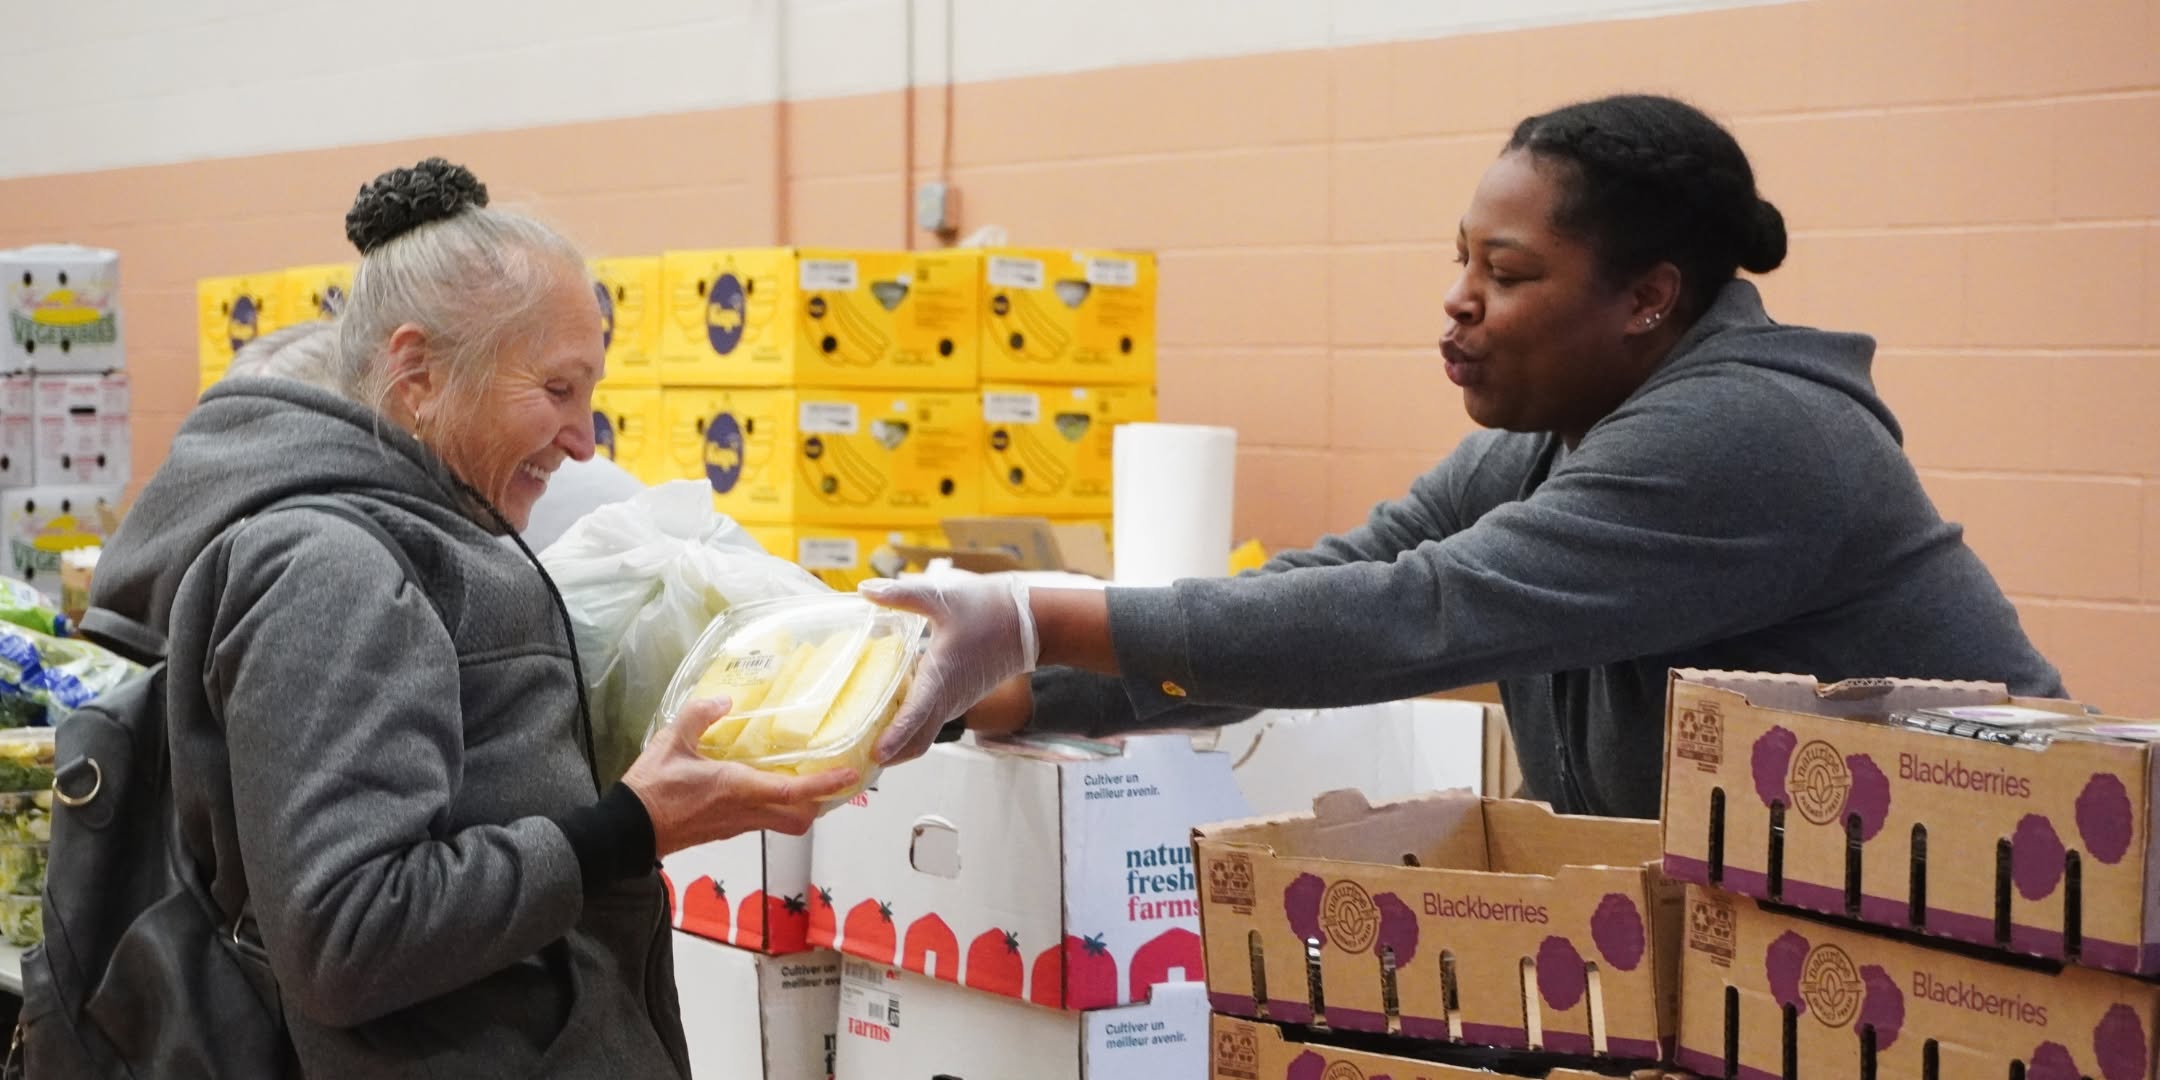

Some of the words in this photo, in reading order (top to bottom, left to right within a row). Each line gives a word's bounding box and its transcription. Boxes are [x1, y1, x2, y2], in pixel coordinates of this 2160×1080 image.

[1084, 774, 1123, 786] Cultiver
[1126, 774, 1139, 783] un
[1899, 752, 2031, 798] Blackberries
[1085, 787, 1124, 800] meilleur
[1127, 785, 1160, 797] avenir.
[1127, 866, 1195, 894] fresh
[1128, 896, 1199, 921] farms
[1423, 892, 1549, 924] Blackberries
[781, 964, 820, 976] Cultiver
[824, 964, 837, 973] un
[782, 977, 821, 988] meilleur
[1912, 970, 2048, 1026] Blackberries
[1105, 1021, 1149, 1035] Cultiver
[1151, 1021, 1164, 1031] un
[1106, 1035, 1149, 1049] meilleur
[1152, 1031, 1187, 1045] avenir.
